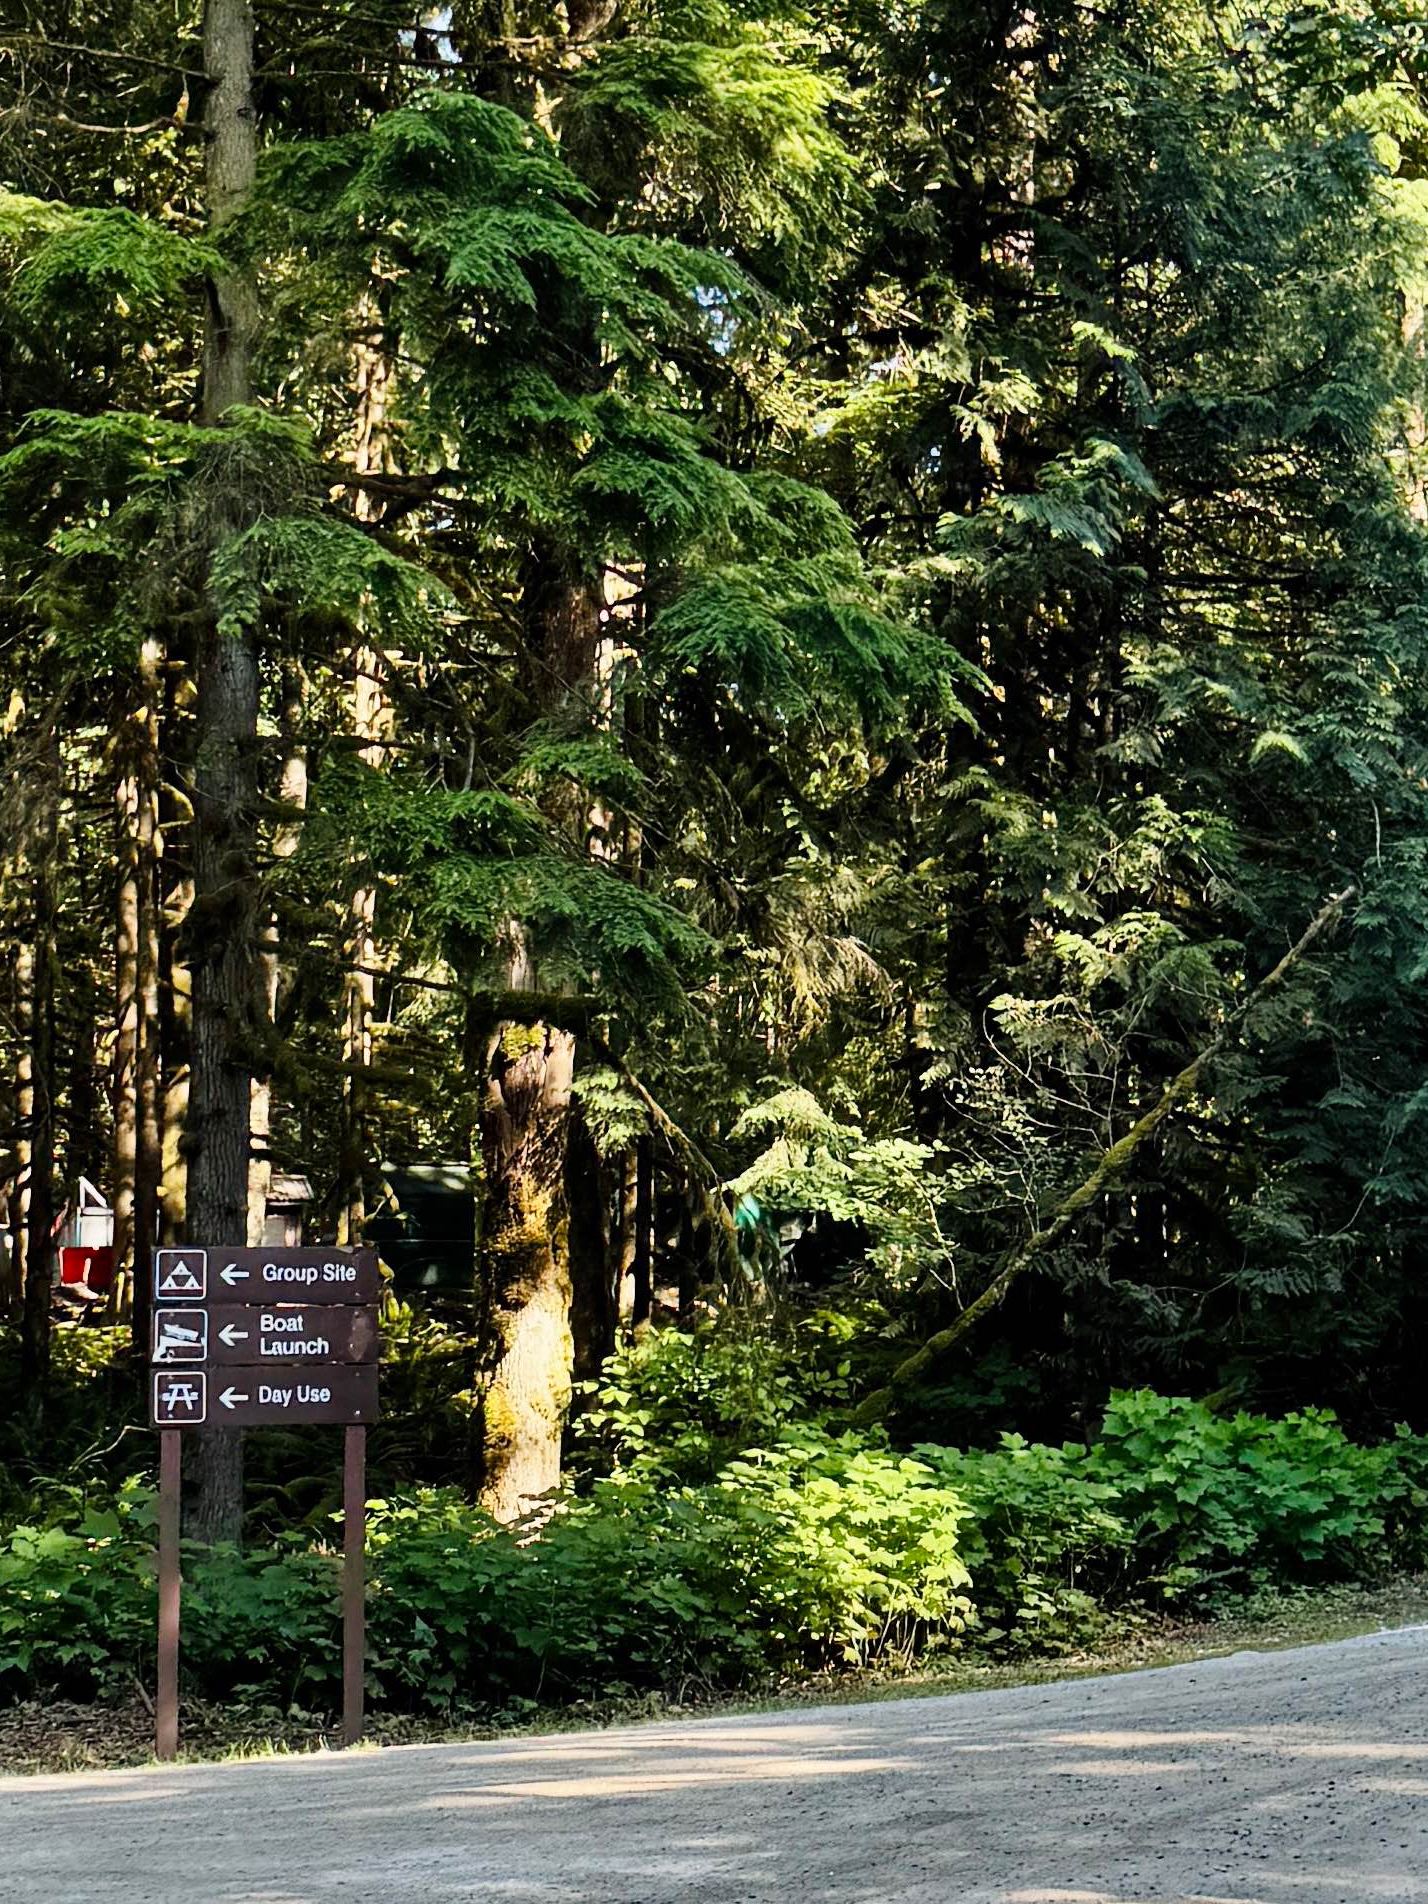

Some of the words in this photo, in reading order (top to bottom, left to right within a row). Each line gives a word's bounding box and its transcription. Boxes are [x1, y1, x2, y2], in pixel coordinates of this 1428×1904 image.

[262, 1263, 319, 1286] Group
[322, 1263, 357, 1282] Site
[260, 1313, 304, 1332] Boat
[260, 1336, 330, 1356] Launch
[258, 1385, 293, 1408] Day
[296, 1384, 332, 1403] Use
